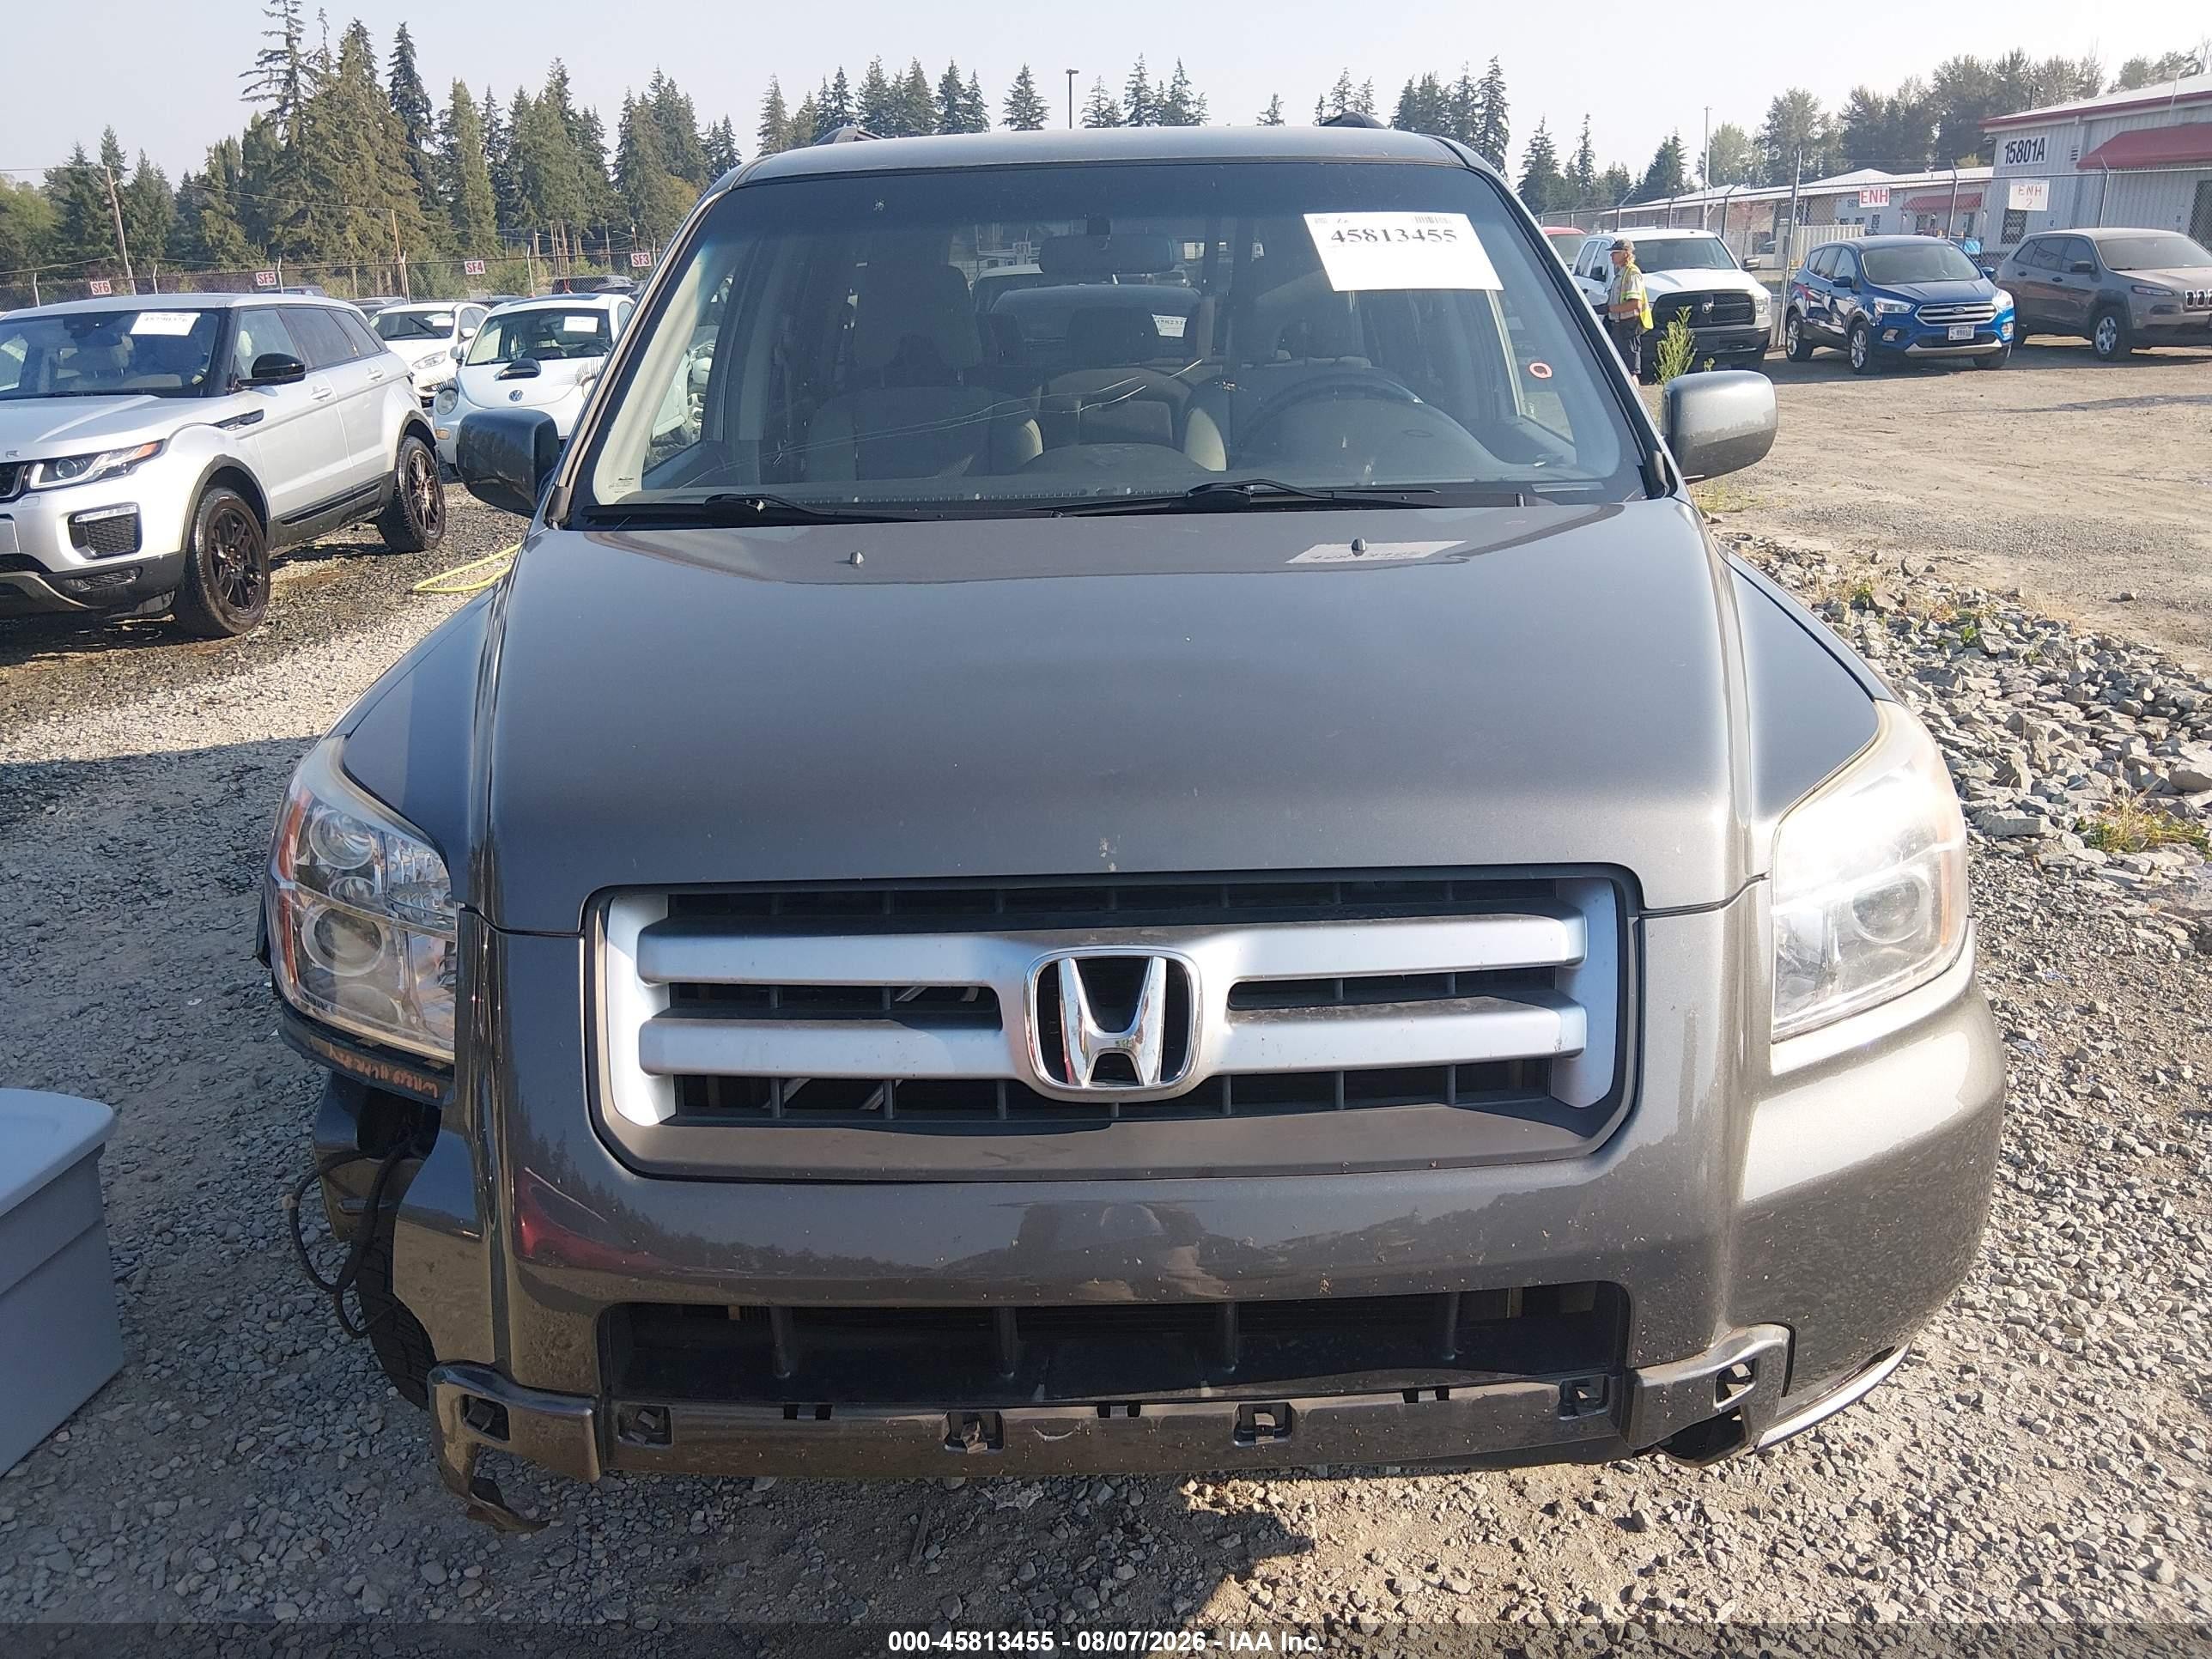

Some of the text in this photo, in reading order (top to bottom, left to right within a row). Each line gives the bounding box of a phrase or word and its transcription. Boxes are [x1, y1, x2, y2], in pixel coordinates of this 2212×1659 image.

[2004, 137, 2045, 164] 15801A
[1860, 188, 1888, 204] ENH
[2018, 184, 2042, 197] ENH
[2026, 198, 2033, 209] 2
[1331, 228, 1457, 243] 45813455
[632, 254, 650, 265] SF3
[465, 262, 484, 273] SF4
[257, 273, 276, 284] SF5
[92, 283, 111, 294] SF6
